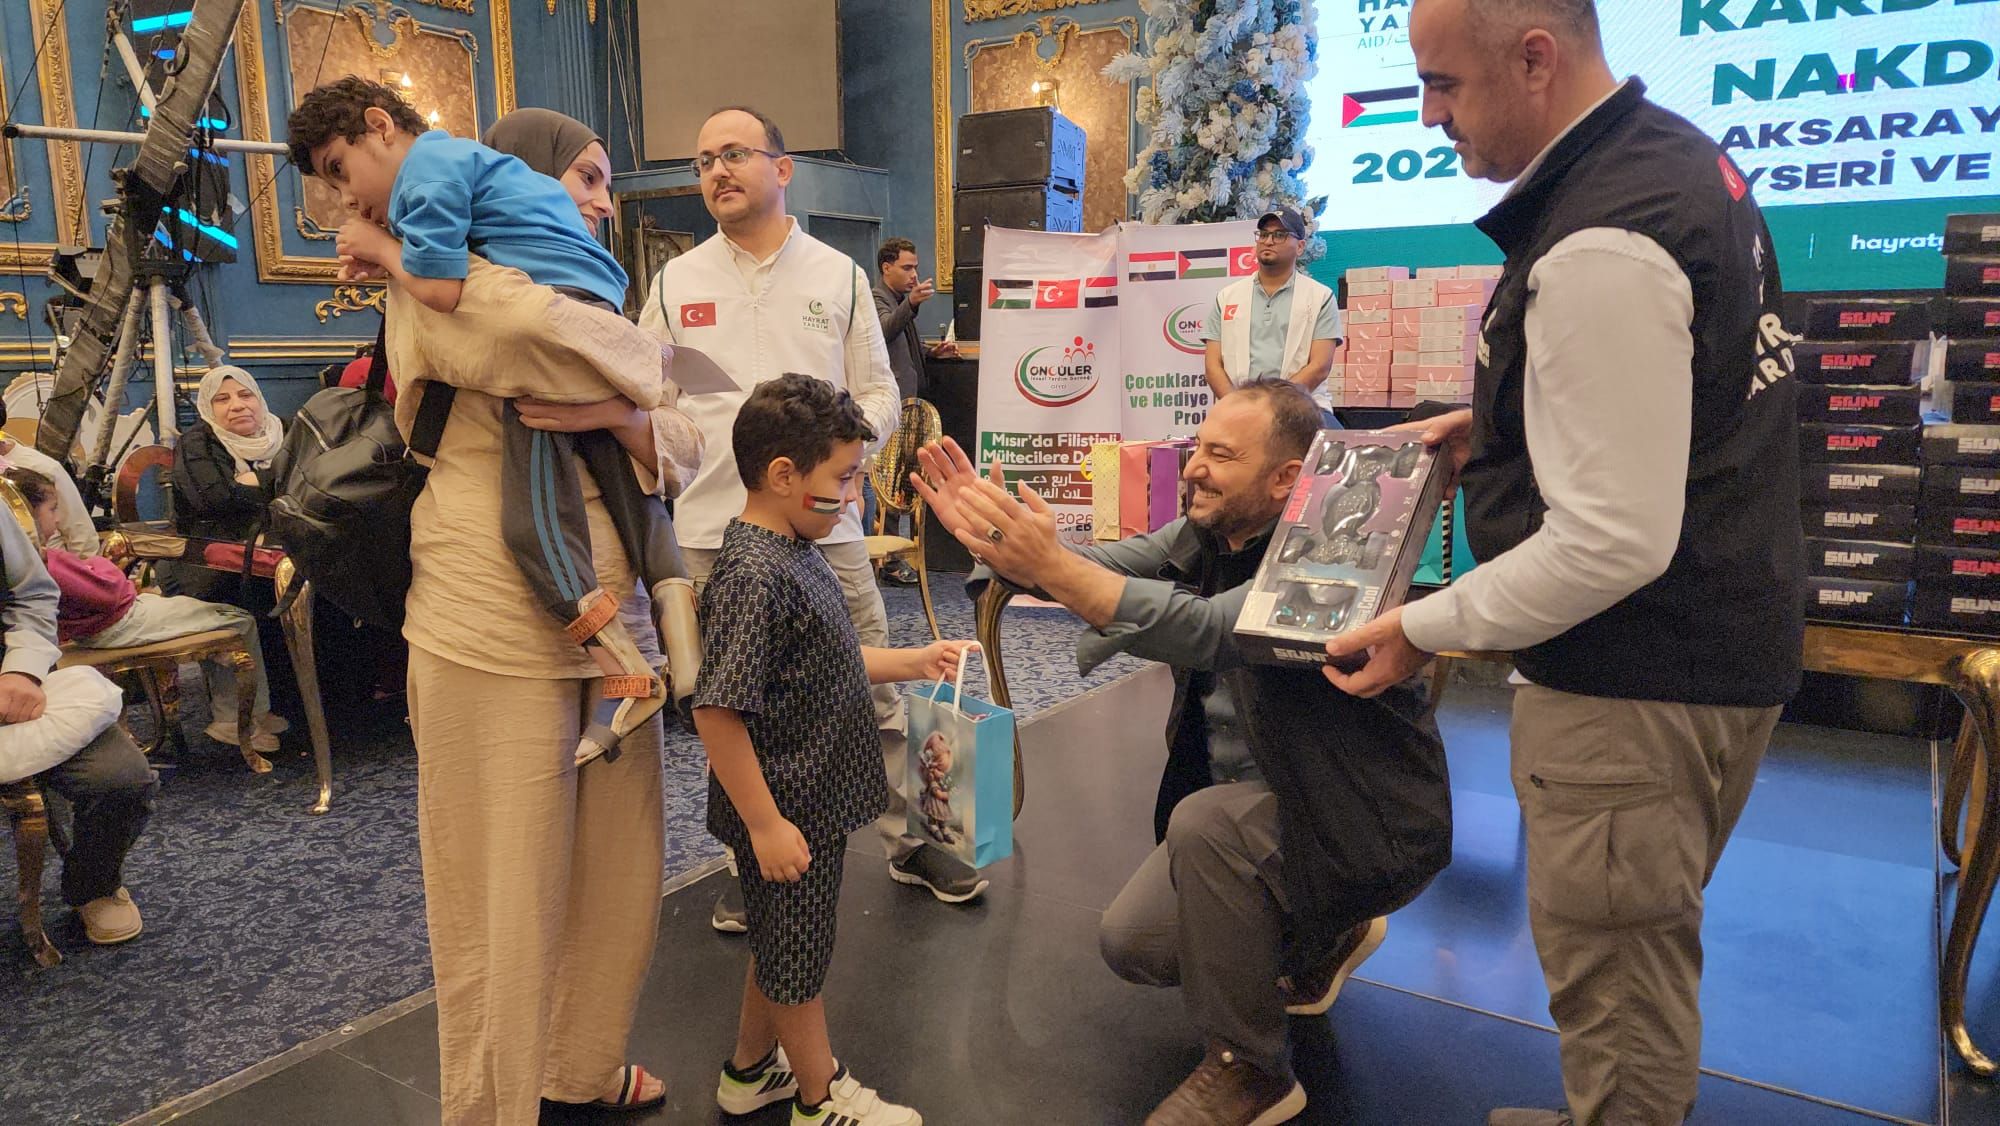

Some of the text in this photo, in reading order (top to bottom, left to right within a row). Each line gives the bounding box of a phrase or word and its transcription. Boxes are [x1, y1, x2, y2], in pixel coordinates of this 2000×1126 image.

[1712, 39, 2000, 105] NAKD
[1352, 146, 1458, 184] 202
[1911, 152, 1992, 183] VE
[802, 315, 830, 325] HAYRAT
[1125, 373, 1207, 392] Çocuklara
[1130, 391, 1208, 408] ve Hediye
[992, 433, 1053, 447] Mısır'da
